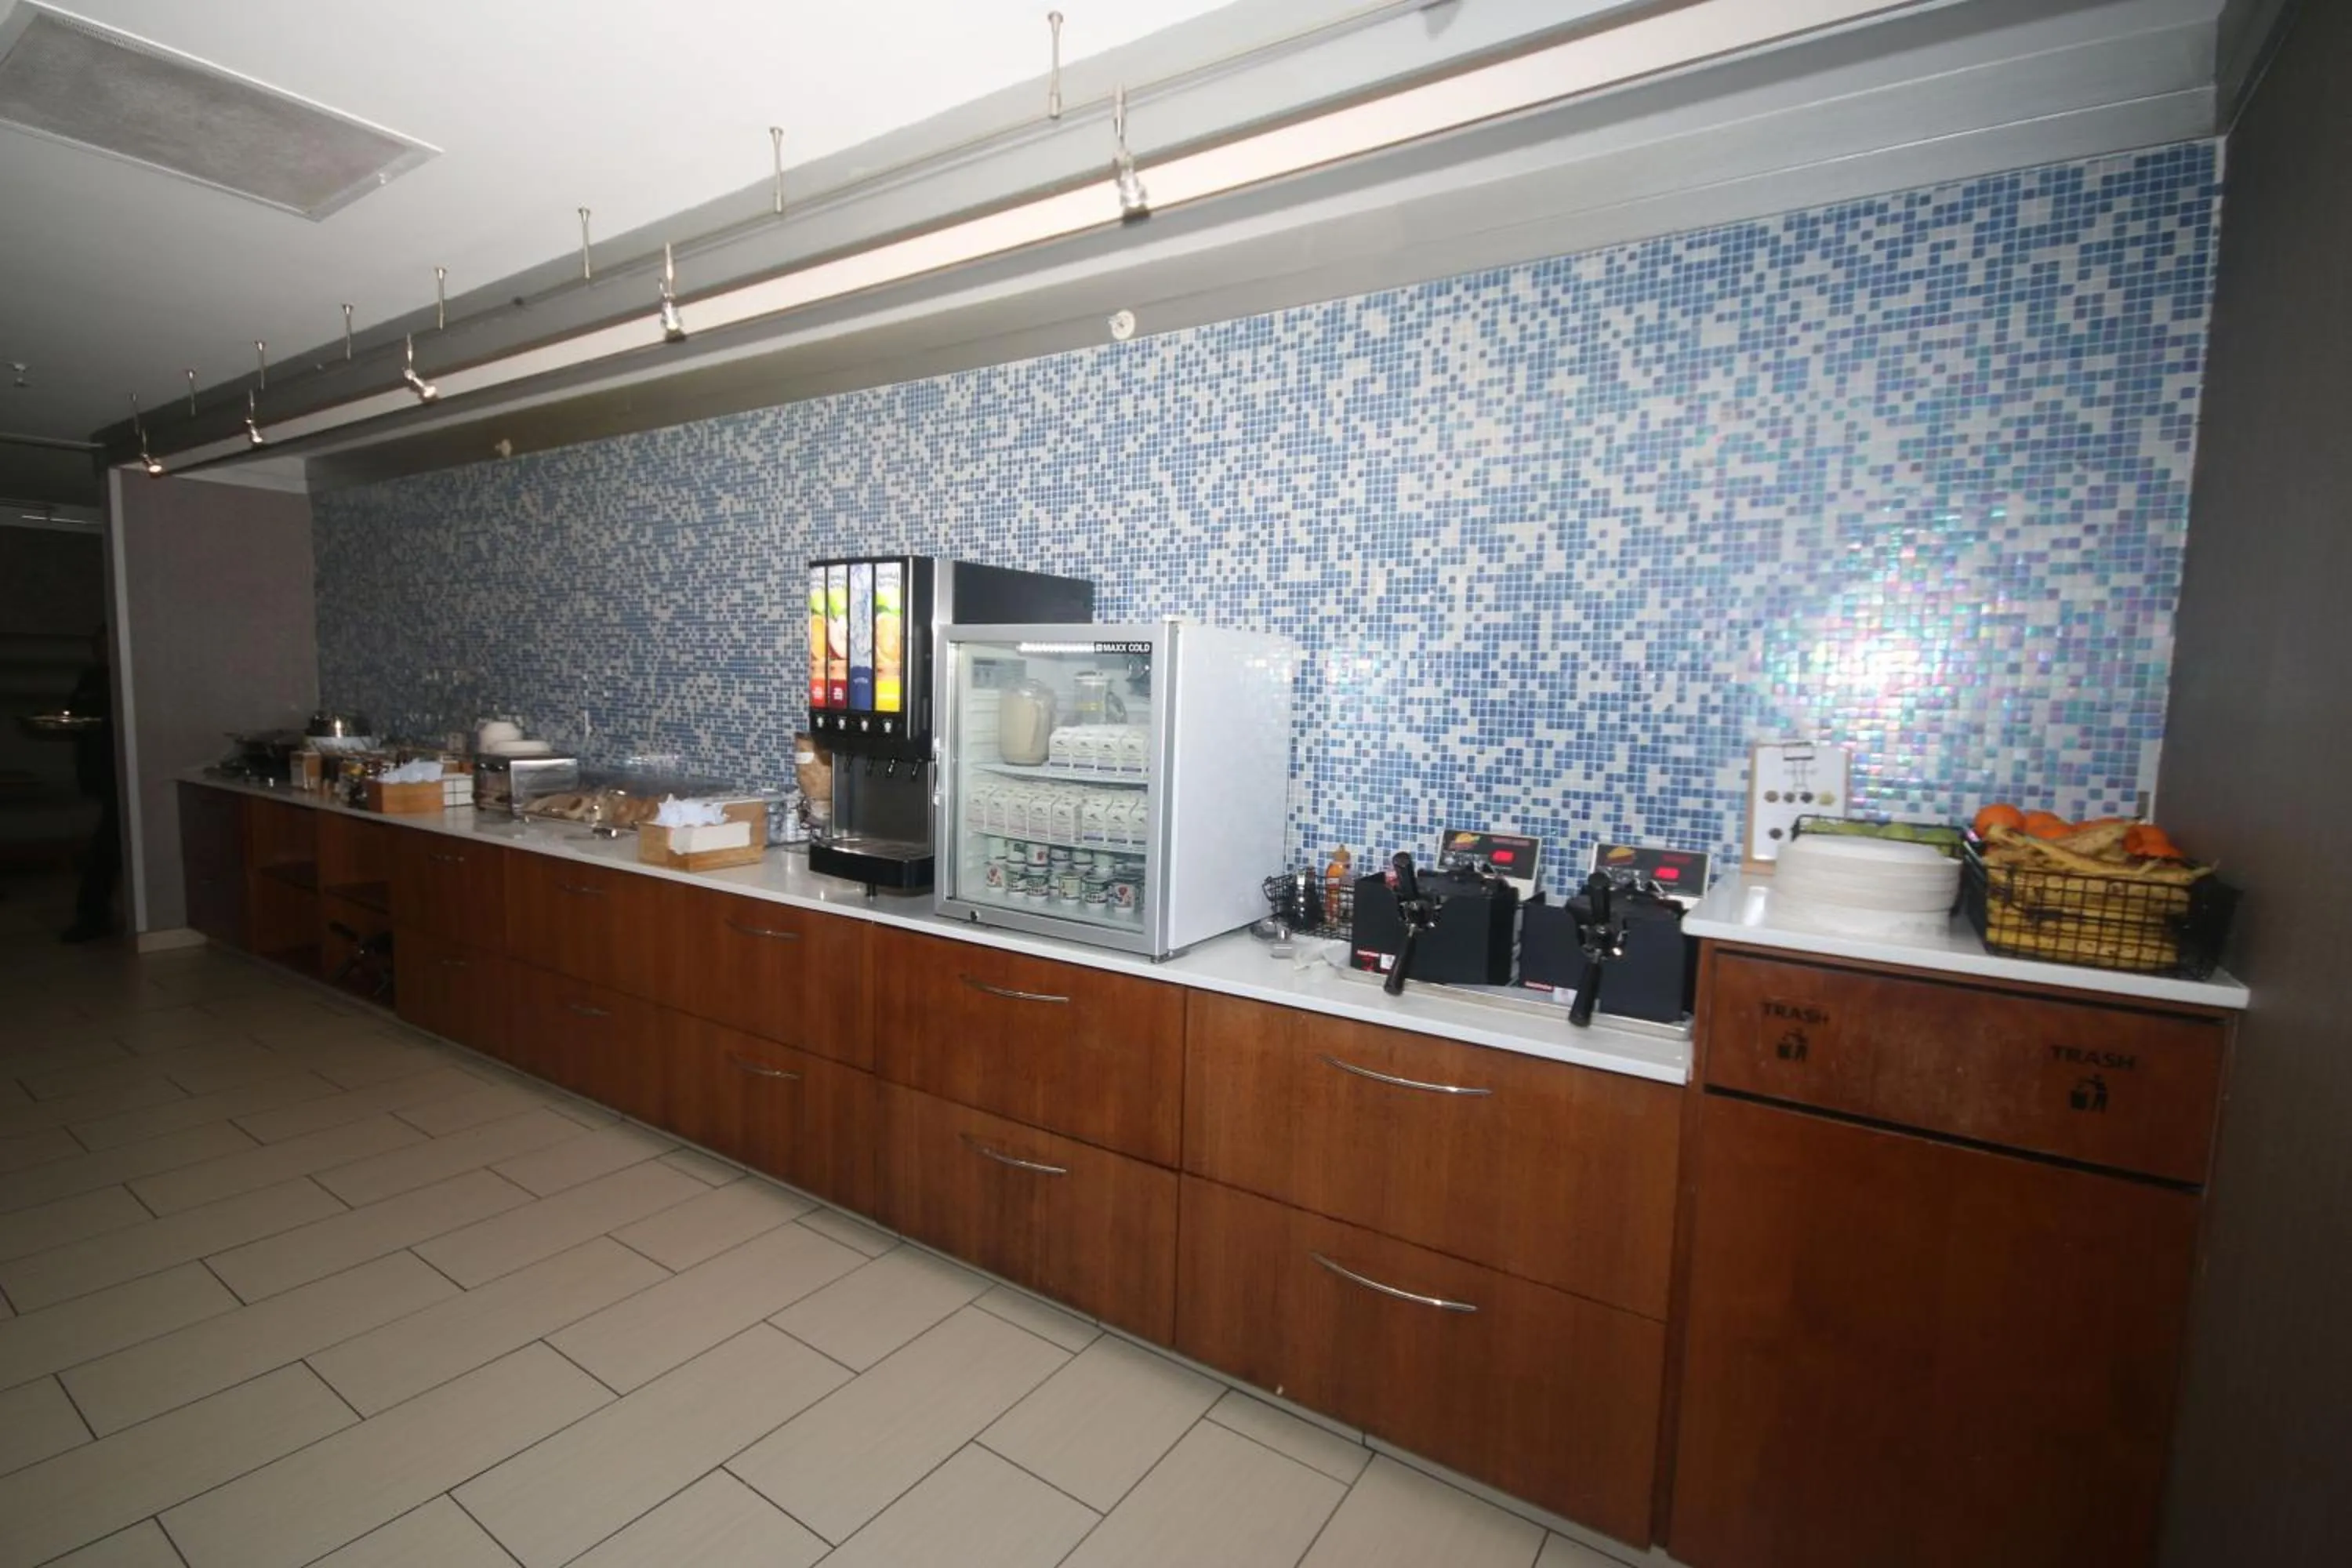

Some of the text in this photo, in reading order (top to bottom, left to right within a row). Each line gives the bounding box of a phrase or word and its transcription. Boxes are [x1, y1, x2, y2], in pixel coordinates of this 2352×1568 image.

[1103, 643, 1150, 652] MAXX COLD
[1759, 1001, 1829, 1025] TRASH
[2050, 1044, 2136, 1069] TRASH
